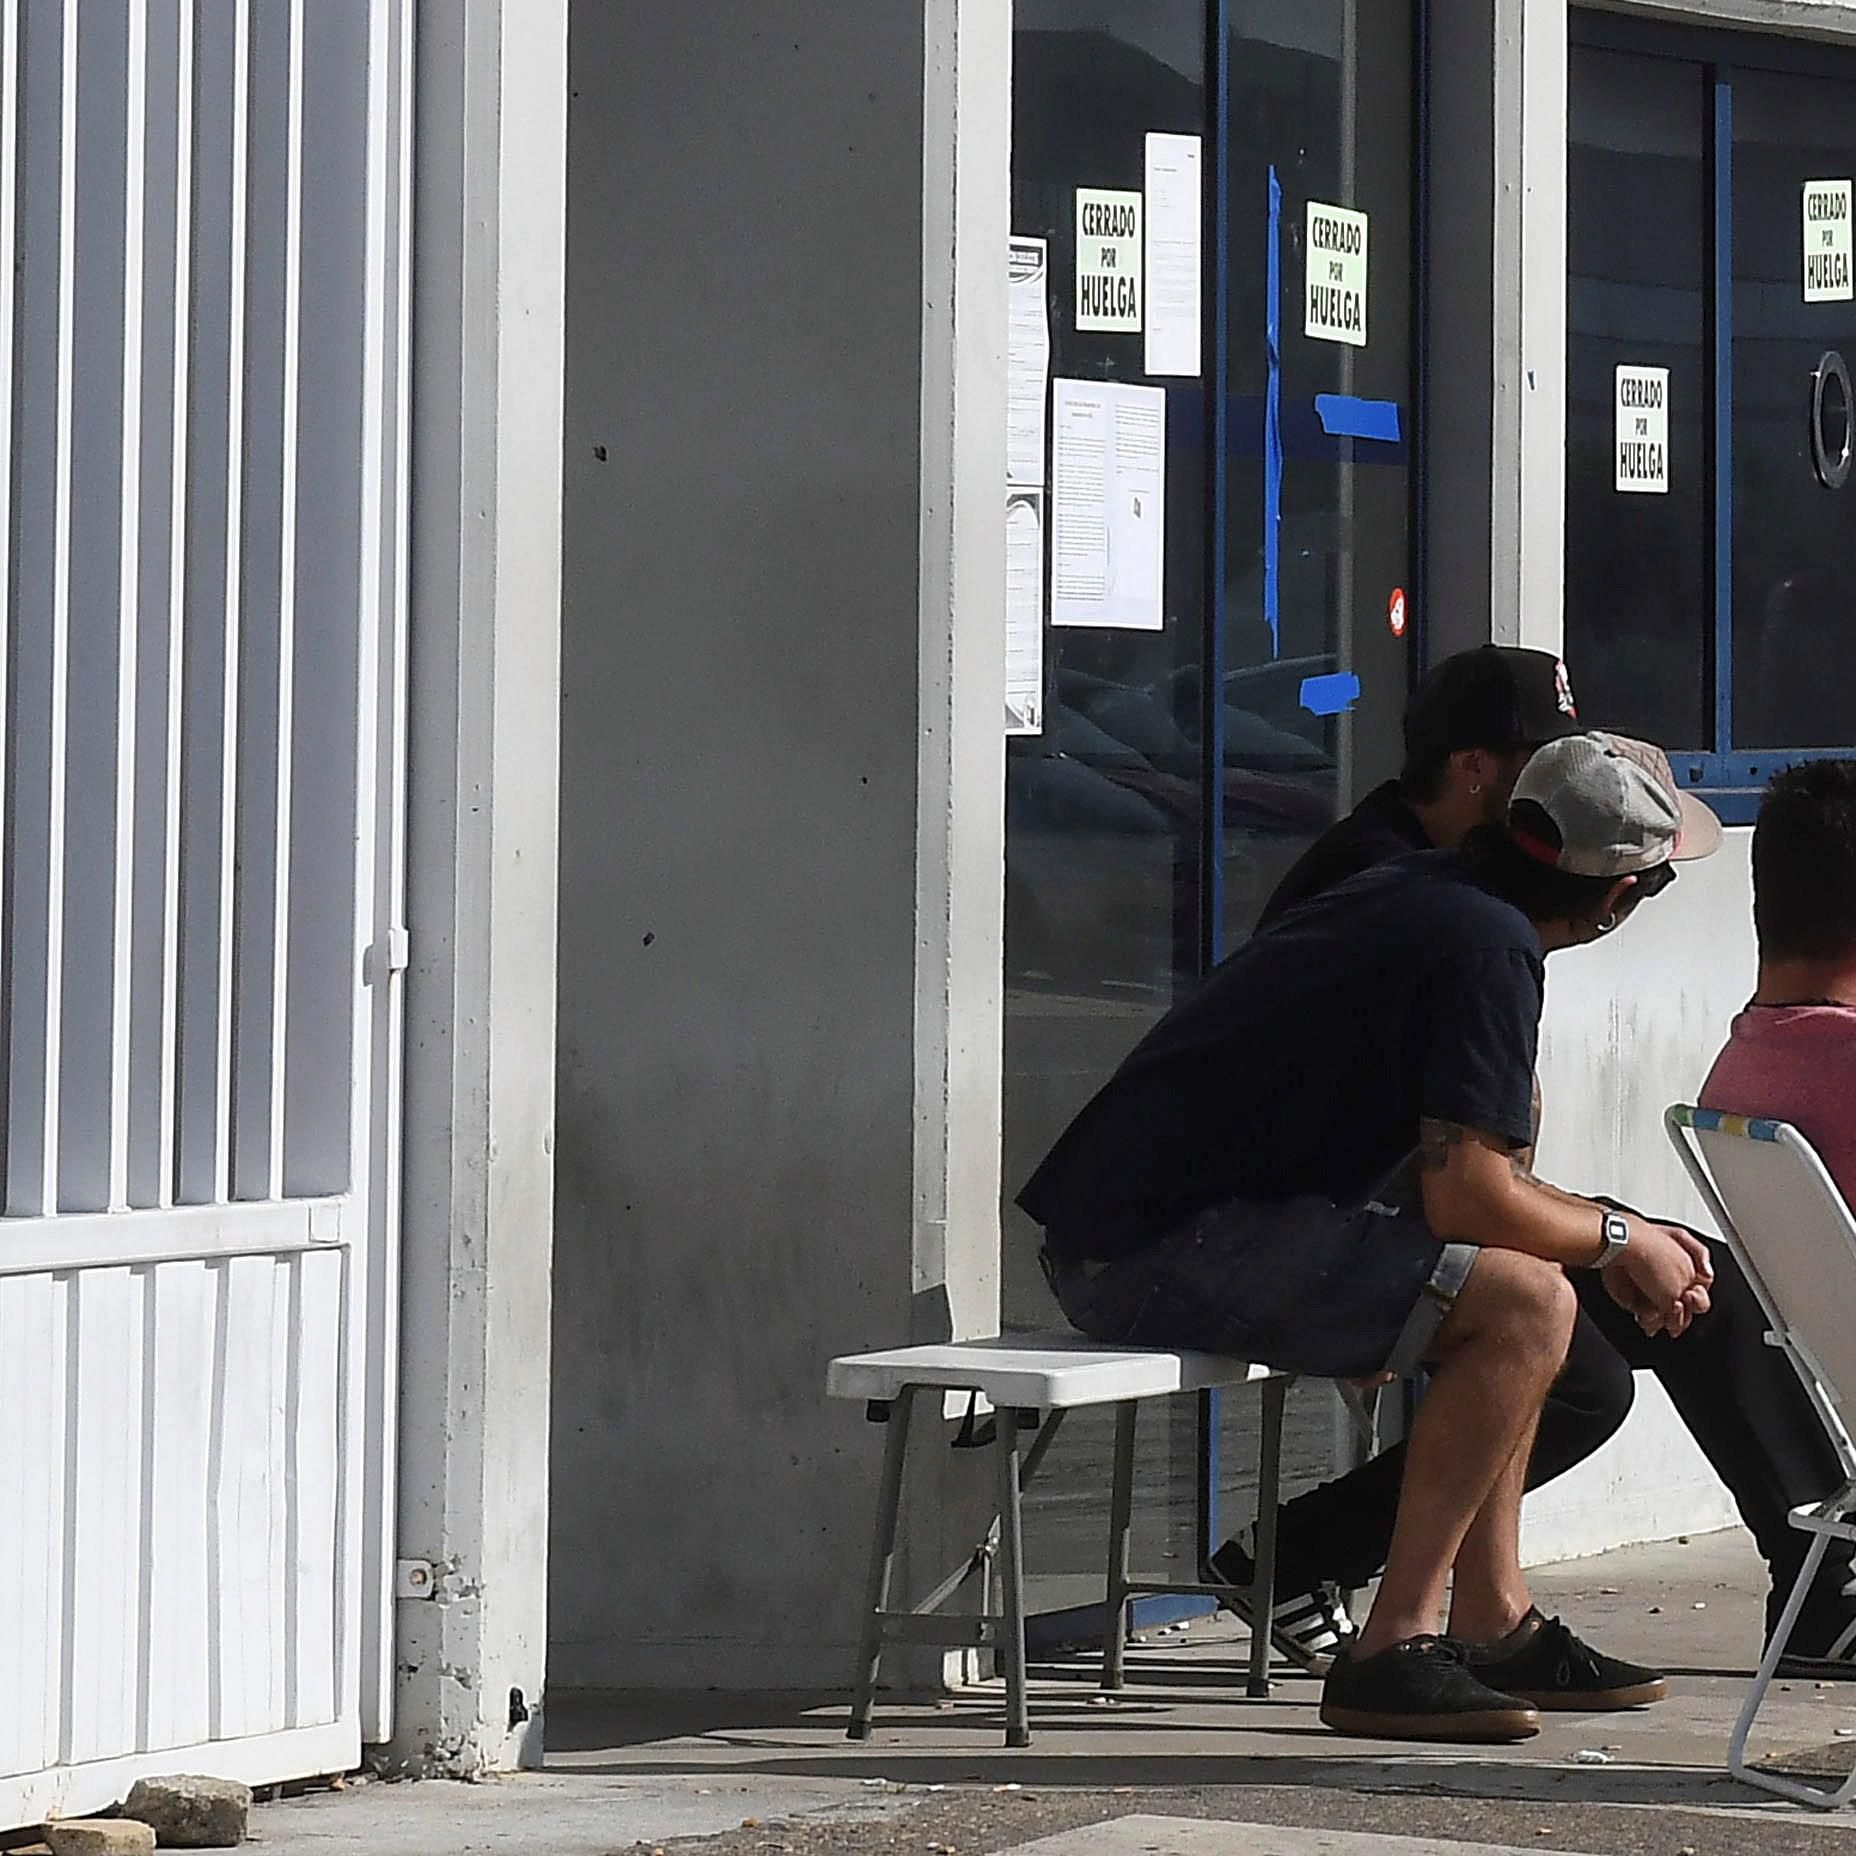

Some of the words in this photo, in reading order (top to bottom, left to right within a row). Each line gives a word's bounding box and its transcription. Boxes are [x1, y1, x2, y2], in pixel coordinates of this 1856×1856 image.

[1082, 202, 1135, 238] CERRADO
[1808, 192, 1847, 221] CERRADO
[1312, 216, 1361, 256] CERRADO
[1101, 247, 1116, 268] POR
[1329, 260, 1343, 282] POR
[1808, 253, 1849, 290] HUELGA
[1081, 275, 1137, 318] HUELGA
[1310, 284, 1361, 332] HUELGA
[1620, 378, 1663, 409] CERRADO
[1620, 442, 1663, 480] HUELGA
